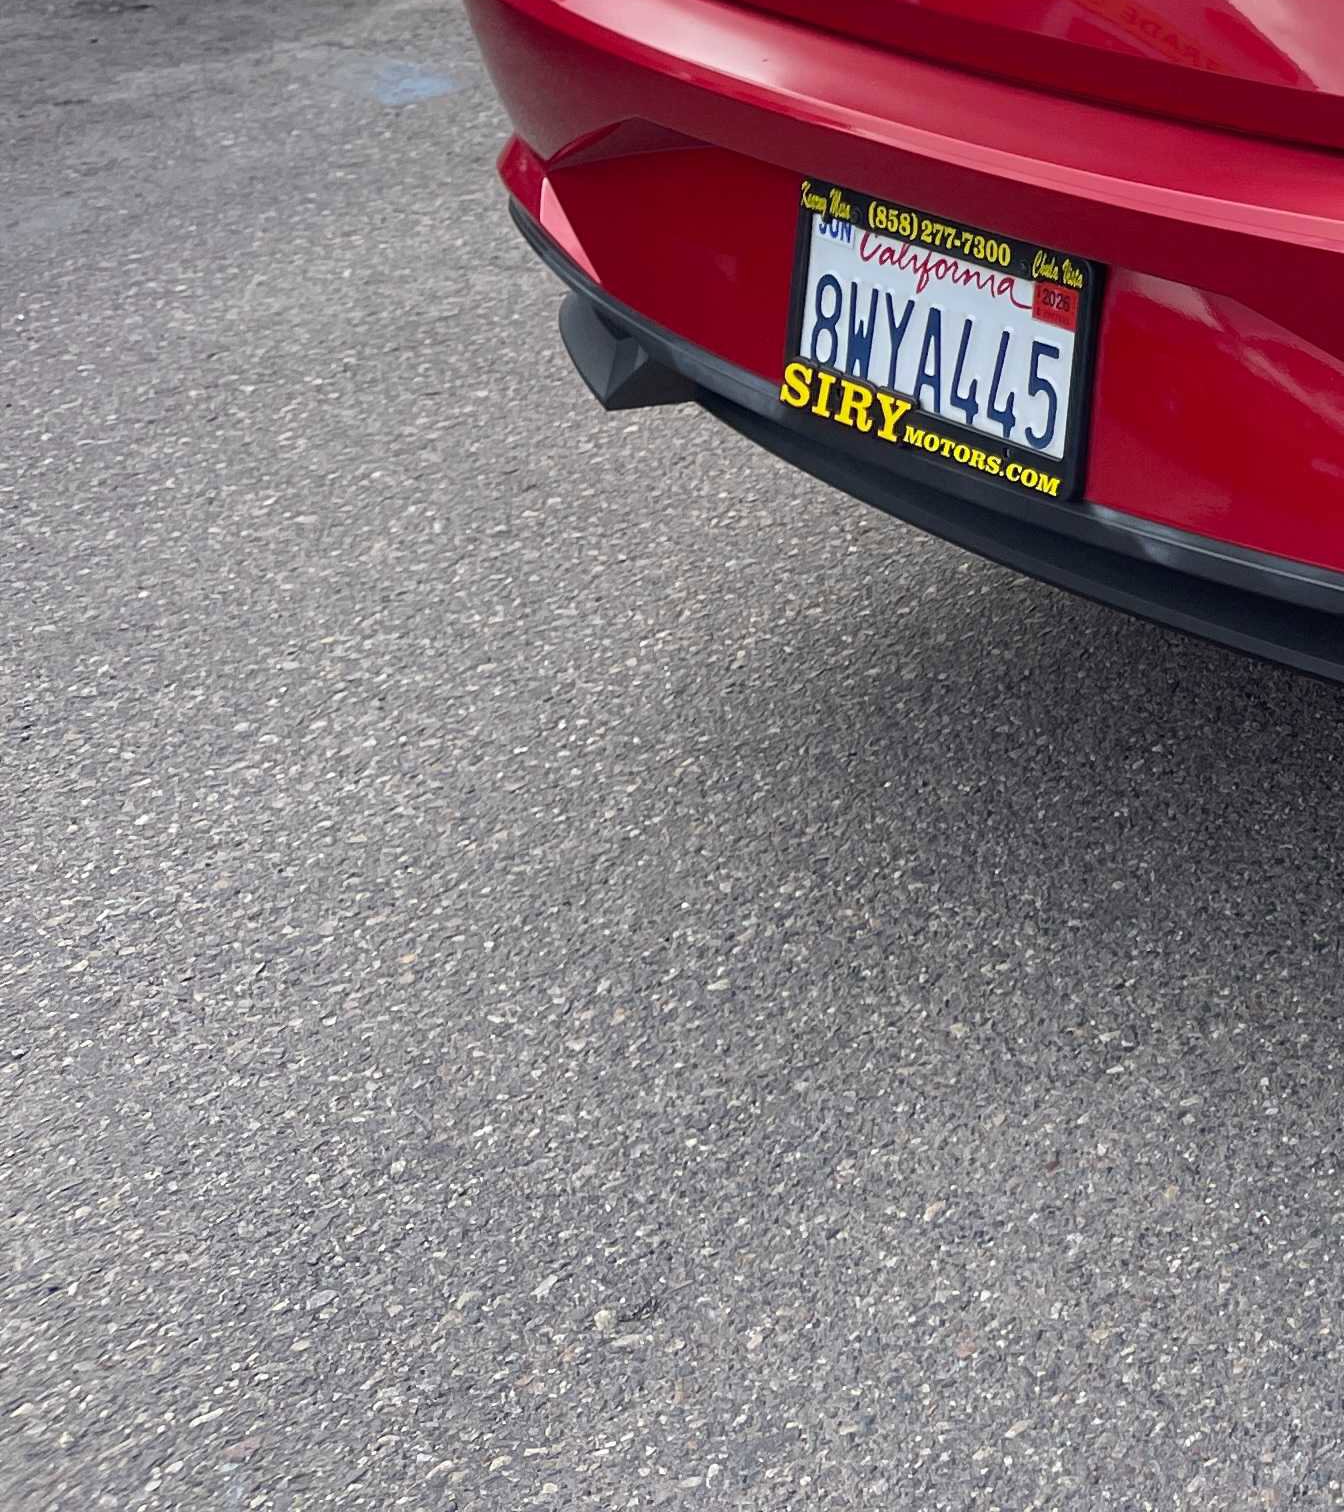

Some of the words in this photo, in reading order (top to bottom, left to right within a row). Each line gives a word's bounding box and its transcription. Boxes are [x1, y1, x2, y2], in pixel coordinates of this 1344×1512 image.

[780, 362, 913, 443] SIRY
[902, 425, 1061, 497] MOTORS.COM
[810, 273, 1061, 450] 8WYA445
